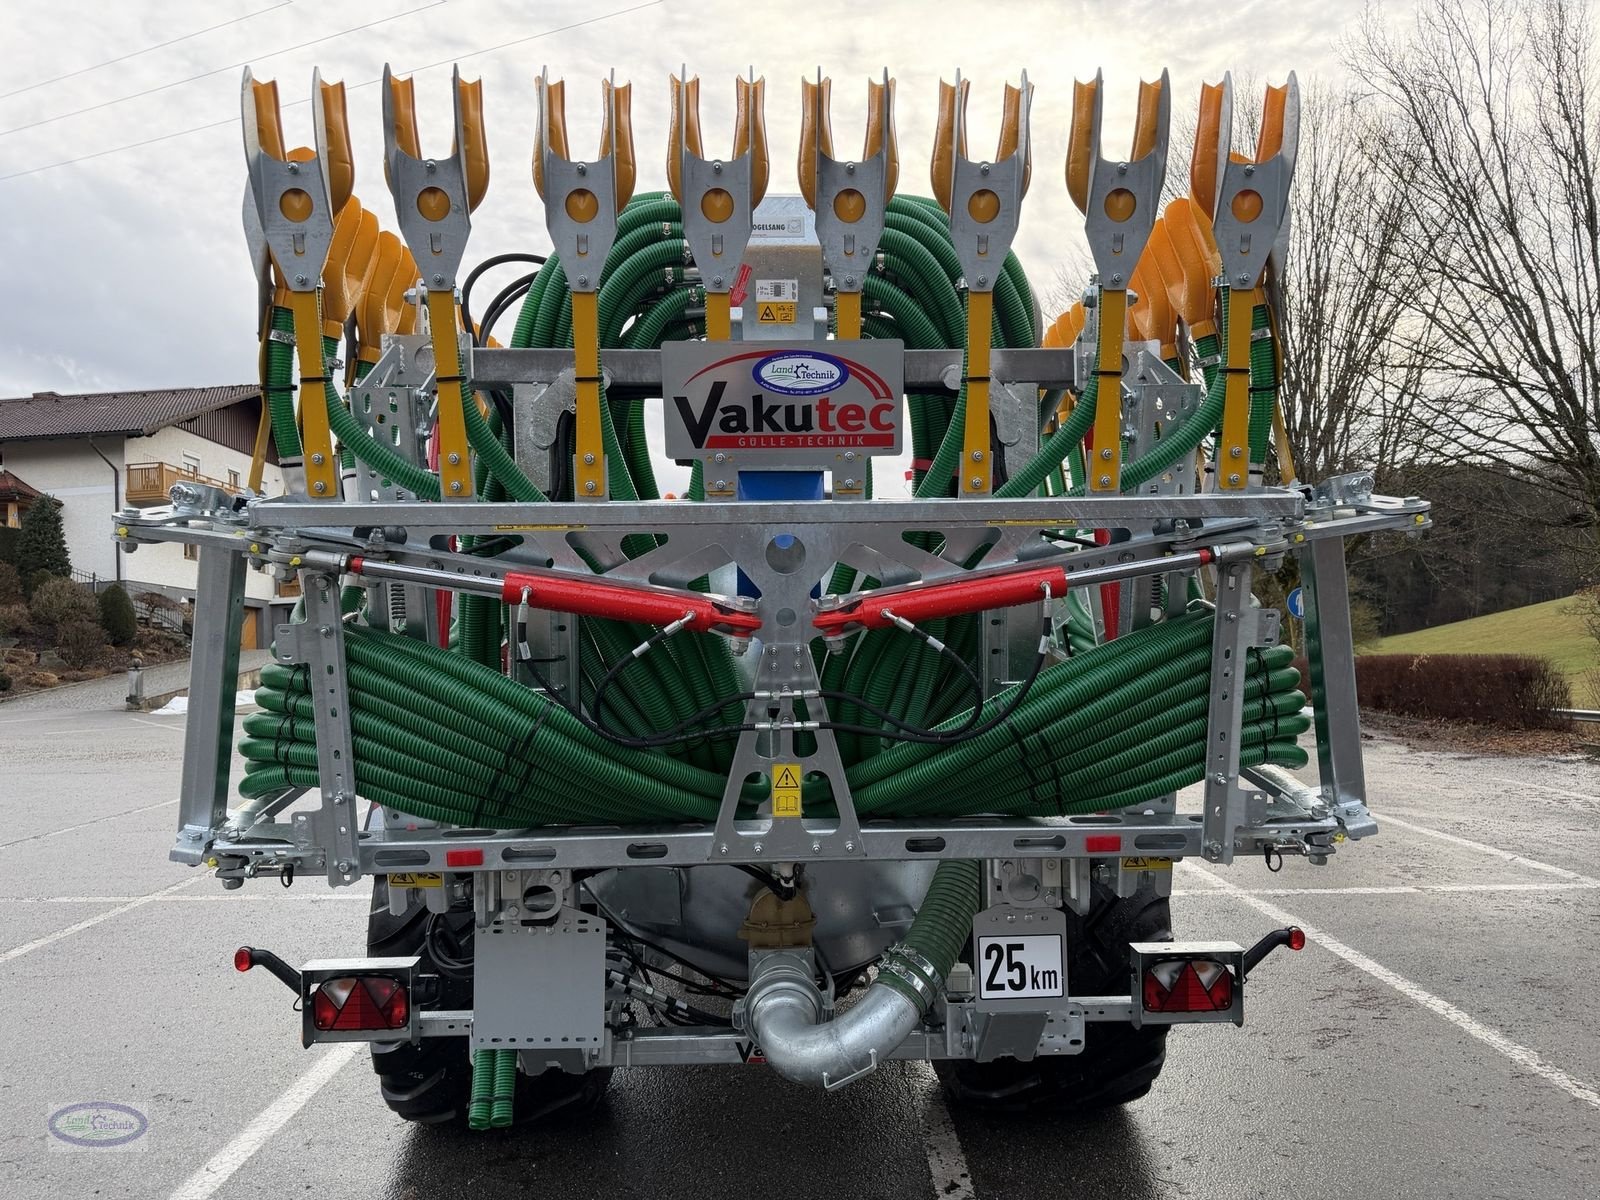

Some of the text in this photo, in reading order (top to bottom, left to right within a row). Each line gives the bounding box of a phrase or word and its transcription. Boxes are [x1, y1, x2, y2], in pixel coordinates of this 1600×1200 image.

[752, 223, 786, 231] OGELSANG
[771, 364, 835, 379] Land Technik
[673, 381, 895, 449] Vakutec
[985, 943, 1058, 991] 25 km
